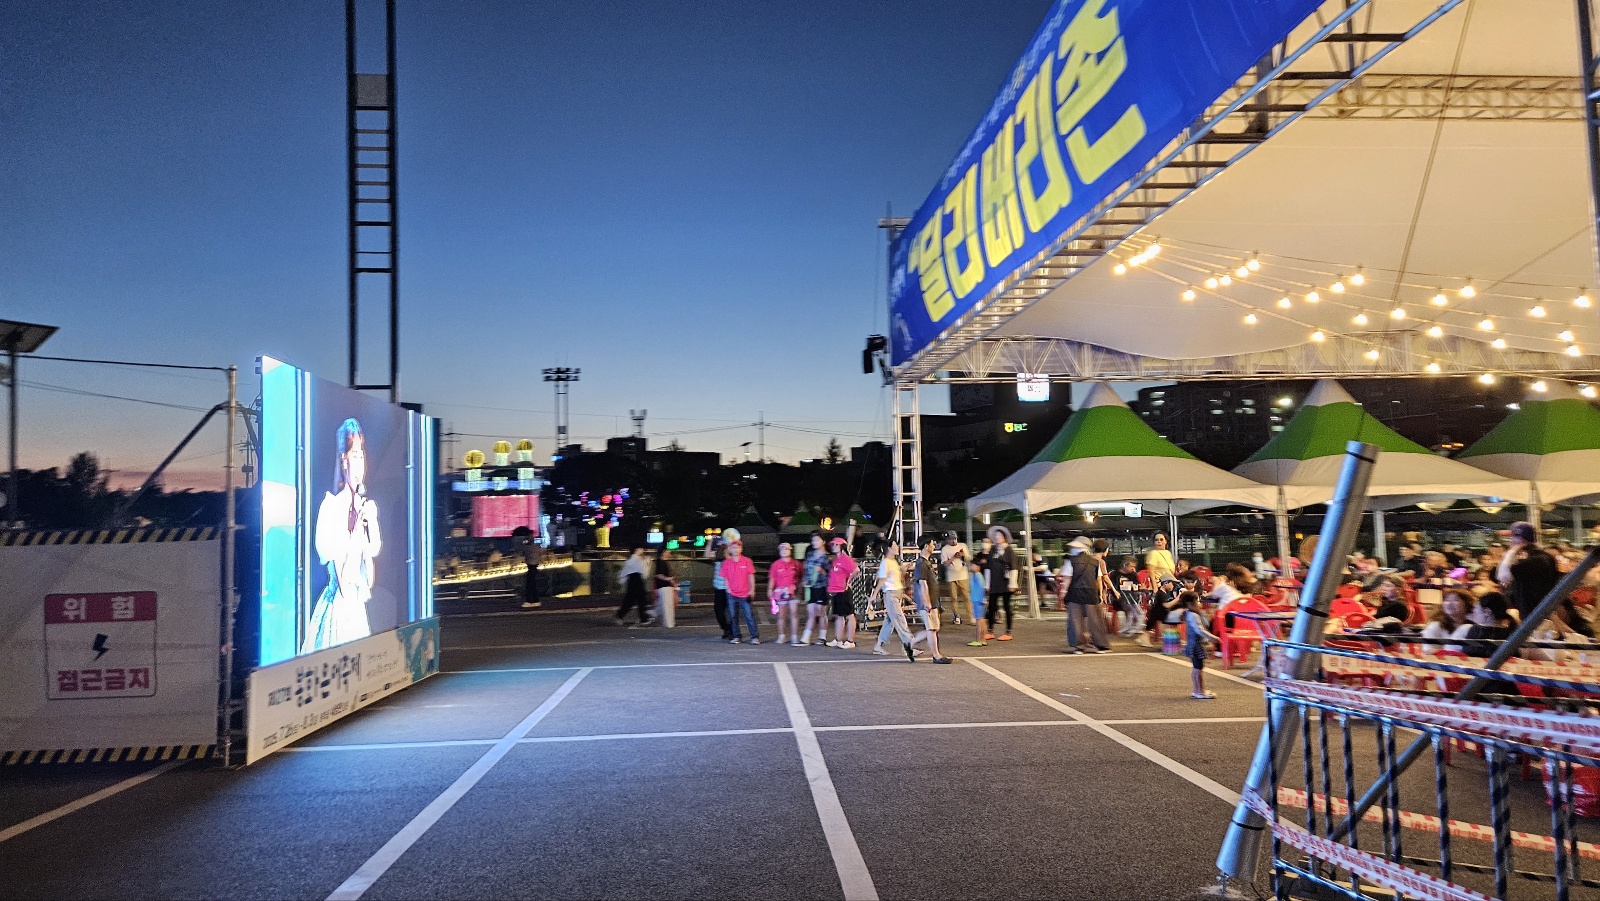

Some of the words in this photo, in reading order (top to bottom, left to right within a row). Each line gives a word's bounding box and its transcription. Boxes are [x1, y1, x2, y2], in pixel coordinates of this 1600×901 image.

[63, 598, 87, 620] 위
[111, 596, 135, 620] 험
[58, 667, 150, 692] 접근금지
